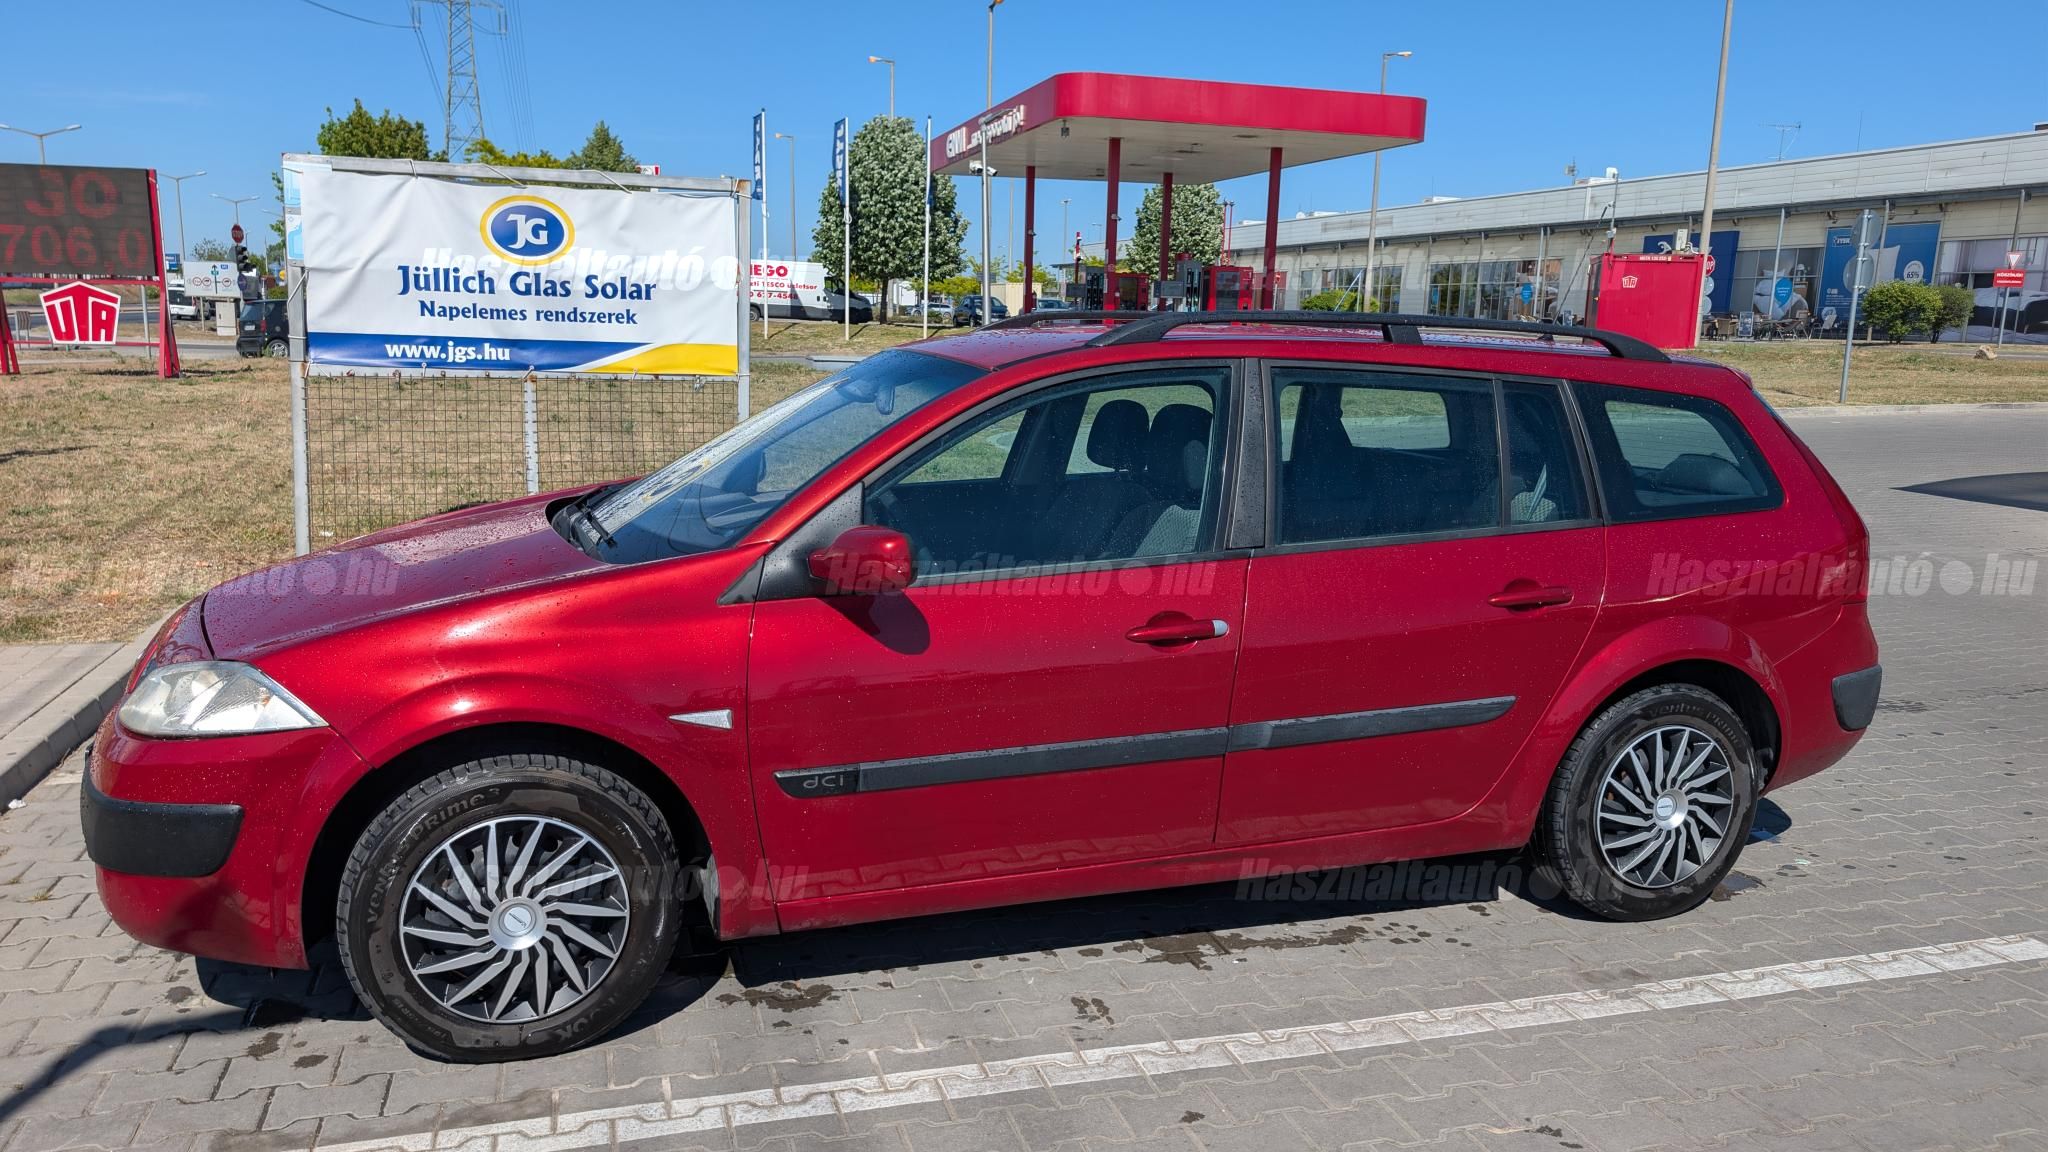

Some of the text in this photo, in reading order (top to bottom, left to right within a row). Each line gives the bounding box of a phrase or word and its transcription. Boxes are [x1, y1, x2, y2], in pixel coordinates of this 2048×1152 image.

[506, 213, 549, 250] JG
[397, 265, 657, 301] Jüllich Glas Solar
[749, 263, 789, 278] IEGO
[40, 281, 121, 344] UTA
[418, 300, 638, 325] Napelemes rendszerek
[385, 340, 511, 363] www.jgs.hu
